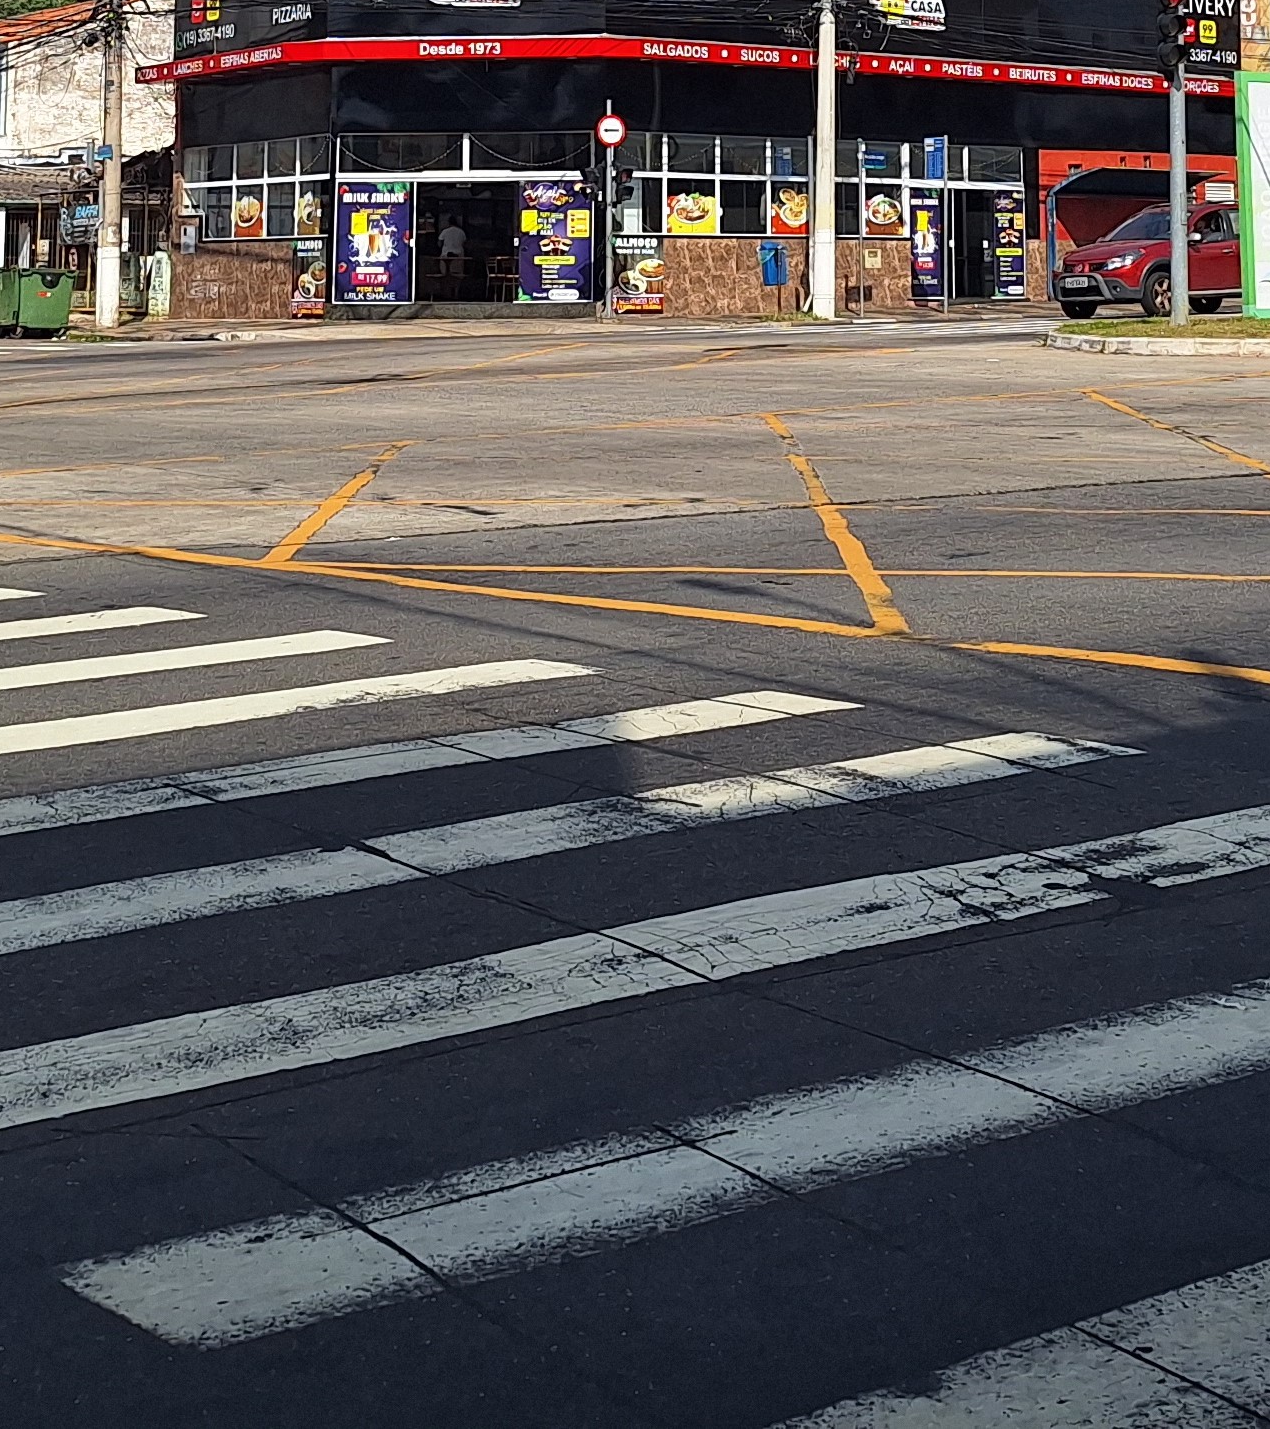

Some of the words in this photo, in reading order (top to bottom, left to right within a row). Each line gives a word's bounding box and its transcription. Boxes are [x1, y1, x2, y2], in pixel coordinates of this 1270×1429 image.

[911, 0, 943, 14] CASA
[273, 4, 312, 25] PIZZARIA
[1203, 24, 1213, 34] 99
[183, 30, 197, 48] (19)
[419, 43, 464, 56] Desde
[468, 42, 501, 55] 1973
[173, 60, 203, 75] LANCHES
[220, 51, 248, 67] ESFIHAS
[250, 47, 282, 65] ABERTAS
[1190, 49, 1237, 64] 3367-4190
[643, 43, 709, 58] SALGADOS
[740, 49, 779, 63] SUCOS
[889, 58, 914, 74] AÇAÍ
[942, 62, 982, 78] PASTÉIS
[1009, 69, 1056, 82] BEIRUTES
[1082, 72, 1120, 87] ESFIHAS
[1122, 76, 1153, 89] DOCES
[1183, 80, 1219, 94] ORÇÕES
[342, 192, 369, 203] MILK
[371, 192, 405, 203] SHAKE
[297, 240, 323, 251] ALMOÇO
[615, 237, 658, 248] ALMOÇO
[366, 292, 396, 301] SHAKE
